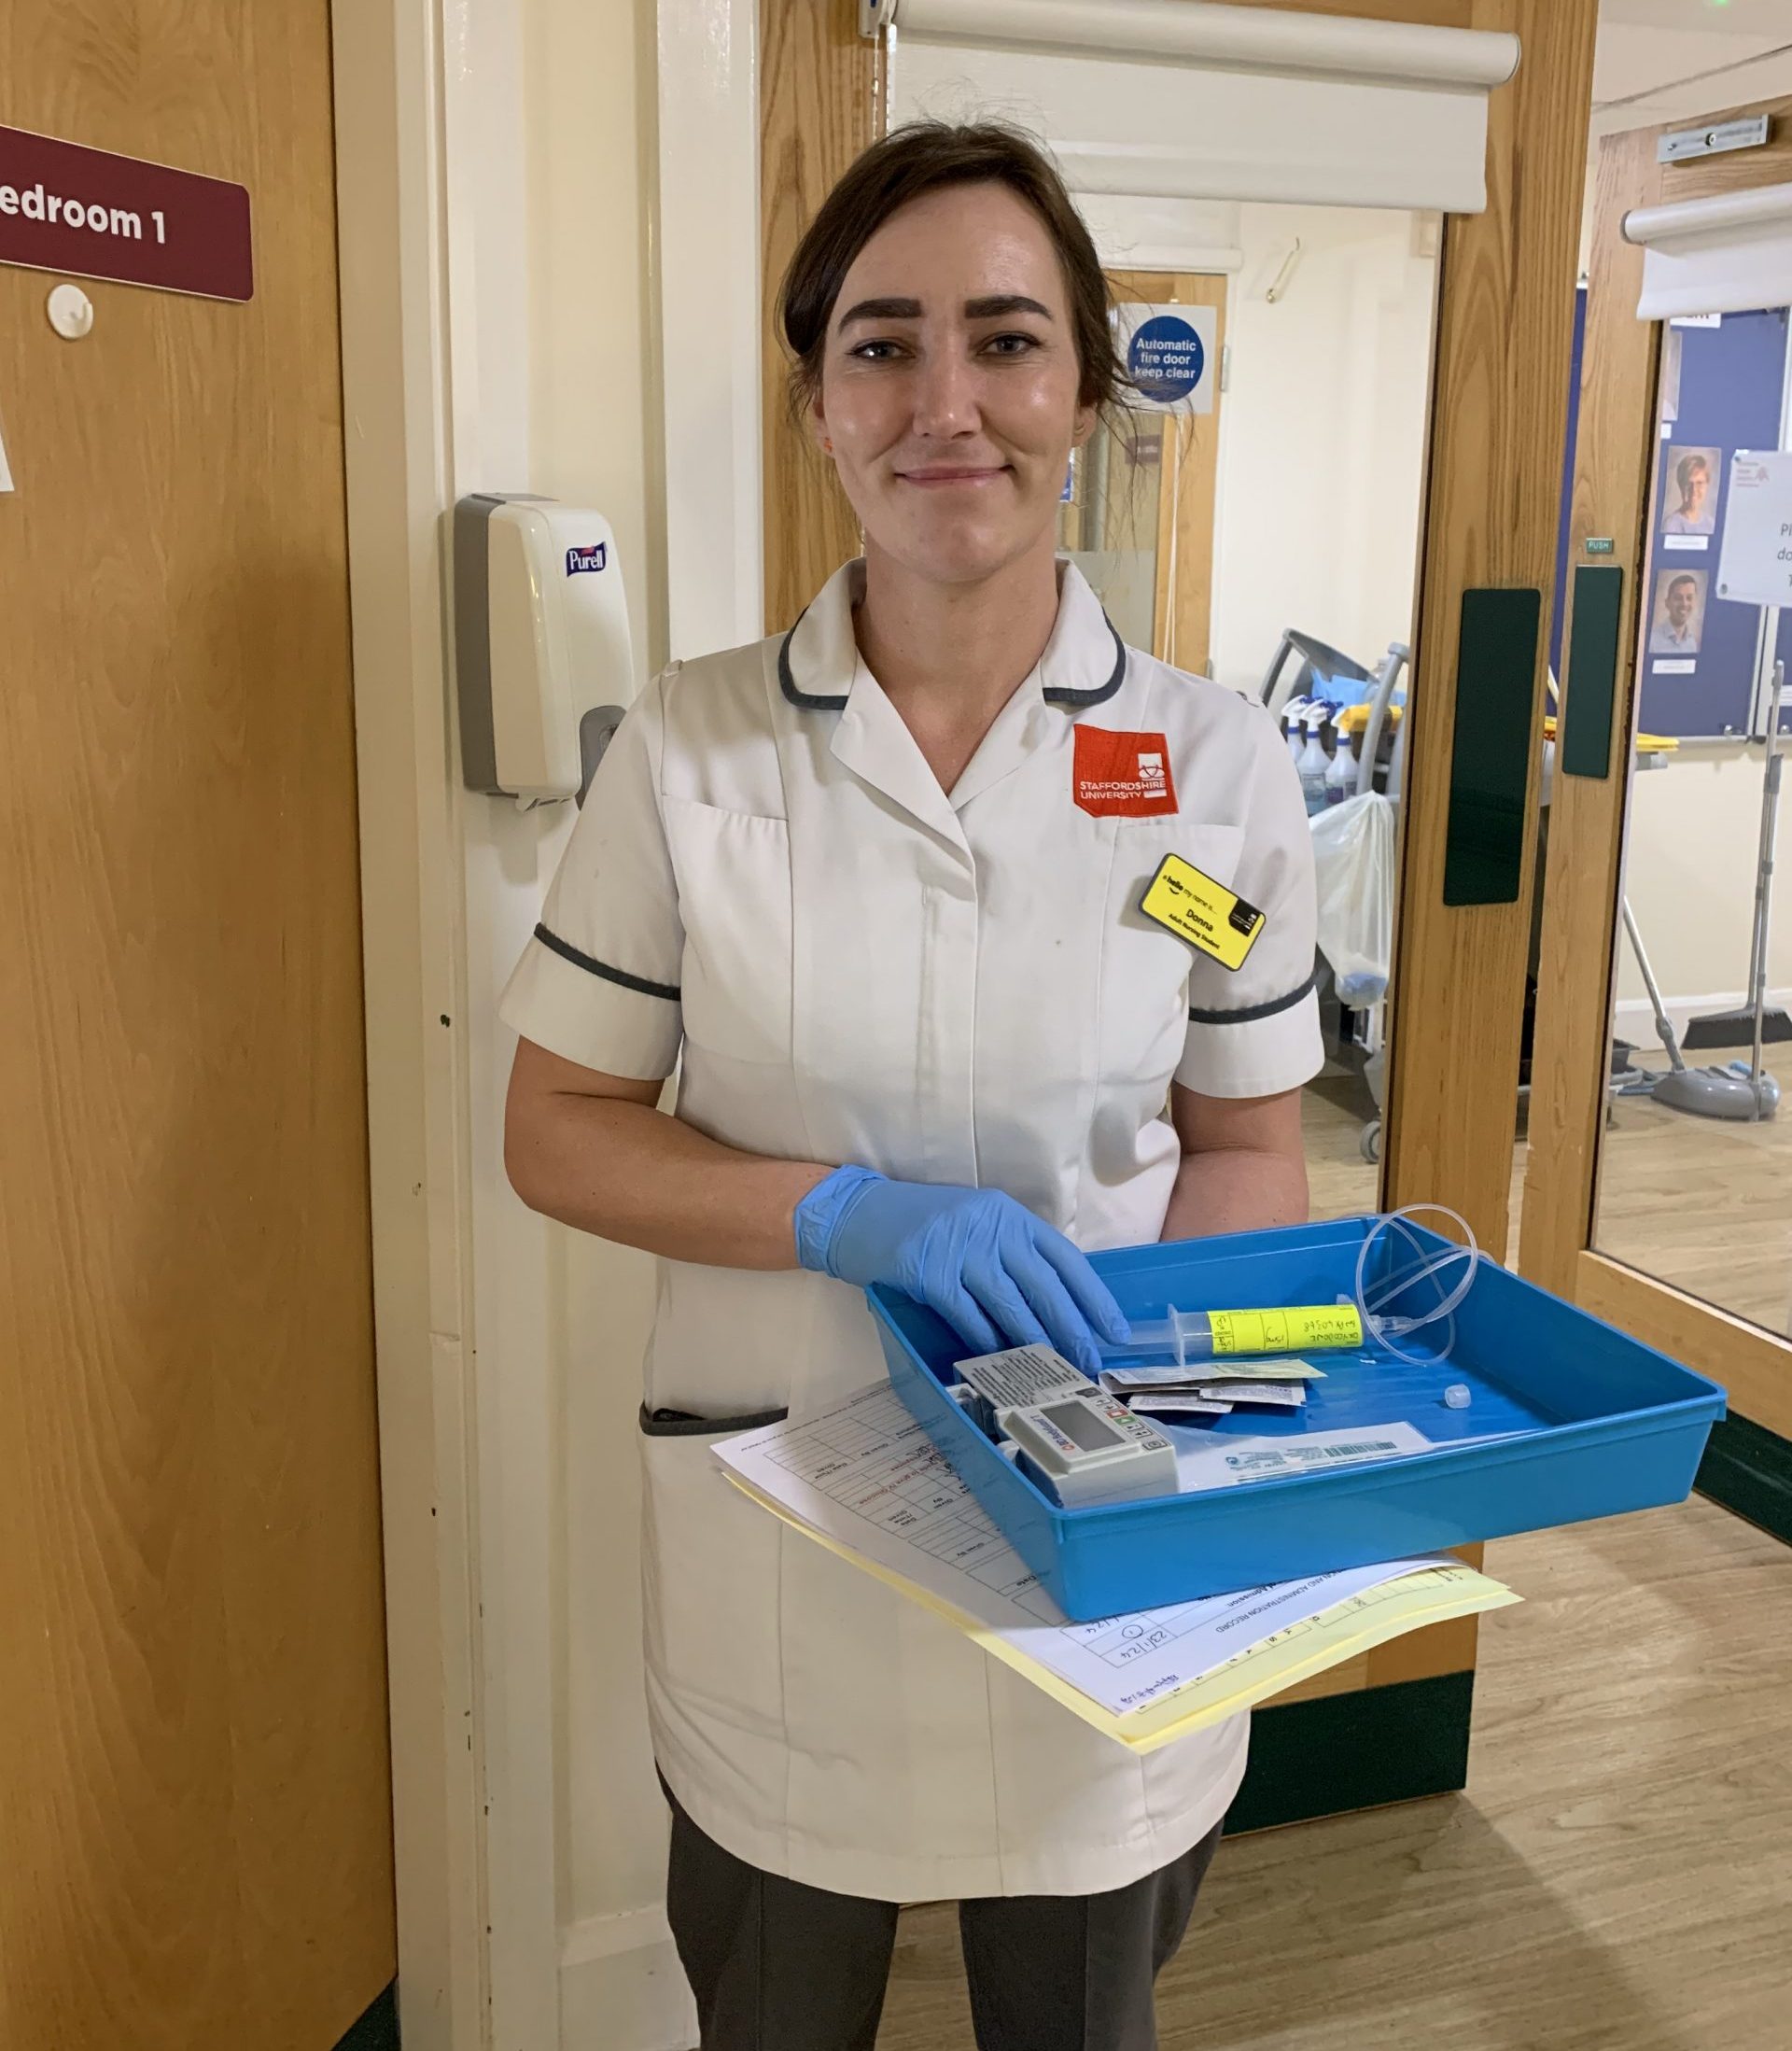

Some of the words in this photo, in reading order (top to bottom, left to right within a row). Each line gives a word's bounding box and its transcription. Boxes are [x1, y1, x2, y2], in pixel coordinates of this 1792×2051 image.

[151, 211, 165, 245] 1
[1136, 338, 1197, 352] Automatic
[1141, 352, 1160, 364] fire
[1163, 353, 1191, 365] door
[1135, 366, 1163, 379] keep
[1166, 367, 1197, 379] clear
[1589, 541, 1609, 550] PUSH
[568, 550, 603, 570] Purell
[1080, 780, 1166, 791] STAFFORDSHIRE
[1080, 792, 1142, 800] UNIVERSITY
[1167, 876, 1183, 891] hello
[1183, 889, 1193, 898] my
[1193, 894, 1208, 906] name
[1185, 908, 1213, 932] Donna
[1169, 913, 1183, 925] Adult
[1183, 921, 1201, 937] Nursing
[1201, 934, 1221, 949] Student
[1308, 1577, 1324, 1589] AND
[1249, 1586, 1309, 1617] ADMINISTRATION
[1215, 1614, 1250, 1634] RECORD
